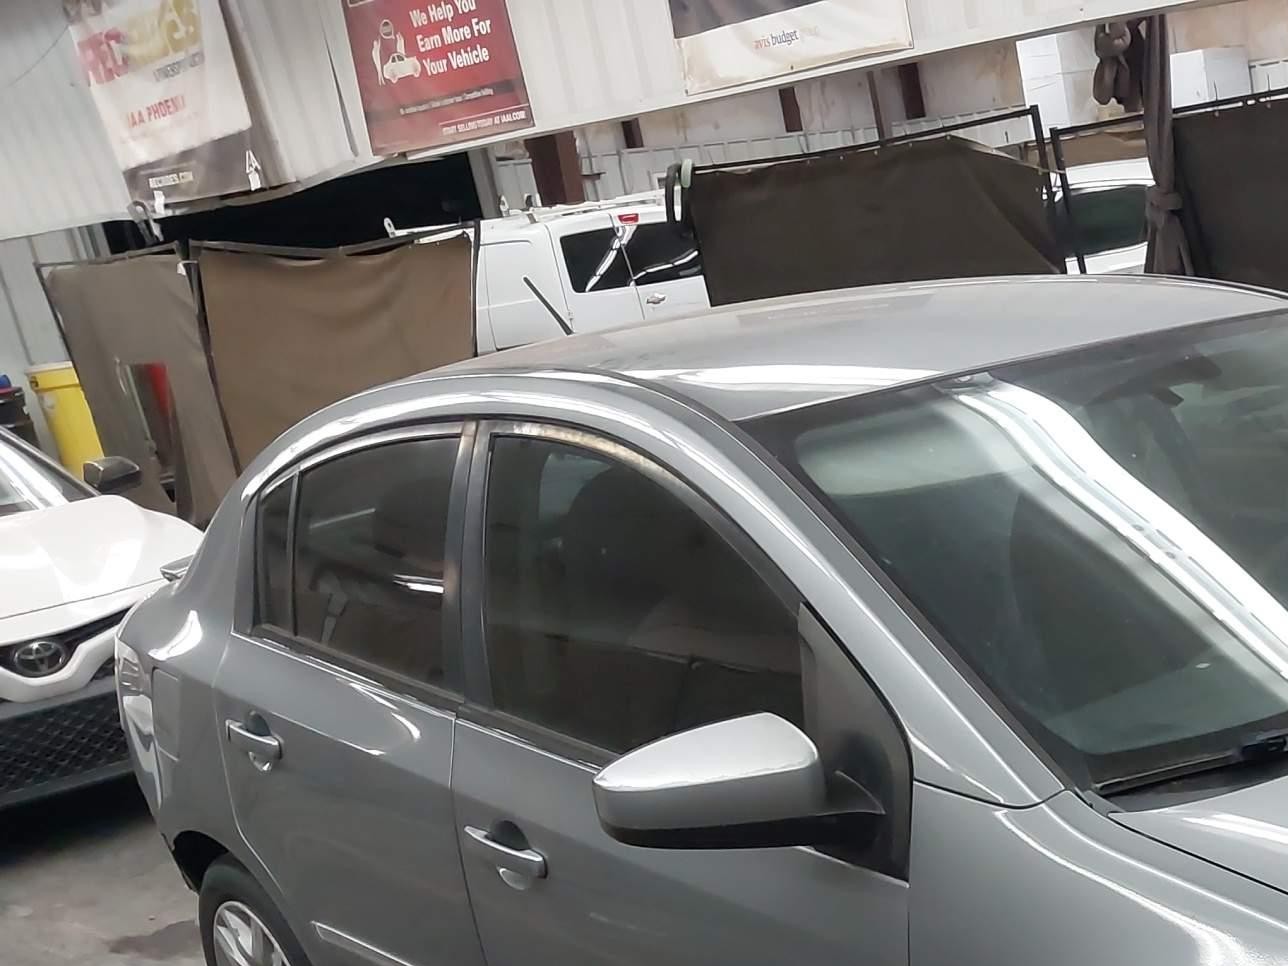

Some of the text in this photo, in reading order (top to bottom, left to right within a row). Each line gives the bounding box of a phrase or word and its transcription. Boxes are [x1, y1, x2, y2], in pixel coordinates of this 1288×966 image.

[410, 0, 477, 28] We Help You
[416, 17, 492, 53] Earn More For
[770, 30, 799, 45] budget
[423, 44, 490, 77] Your Vehicle
[147, 95, 186, 122] PHOENI
